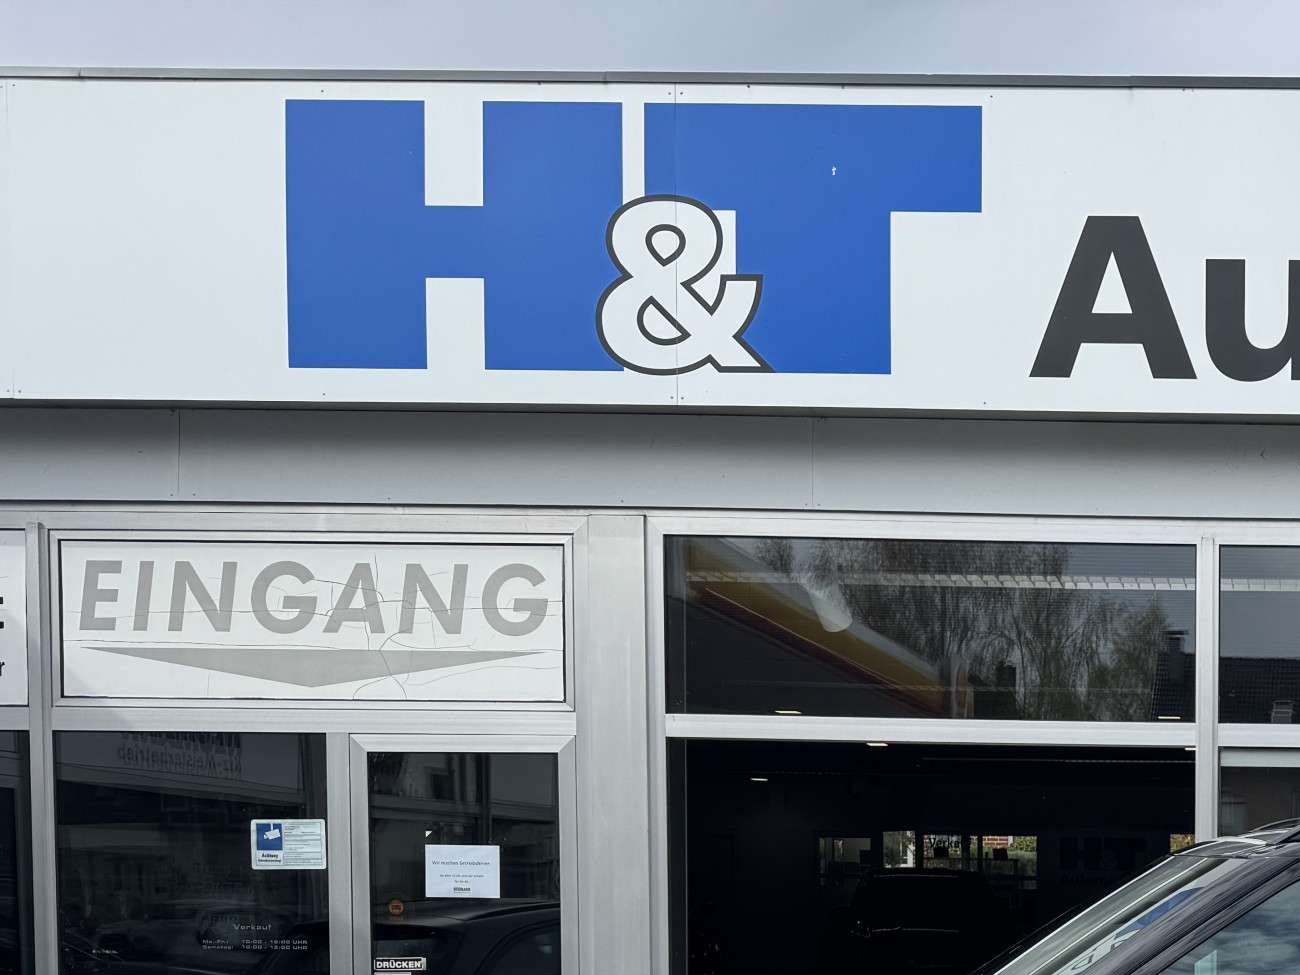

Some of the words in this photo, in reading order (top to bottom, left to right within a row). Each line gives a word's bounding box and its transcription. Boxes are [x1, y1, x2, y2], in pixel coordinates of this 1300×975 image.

[285, 98, 982, 375] H&T
[79, 560, 549, 637] EINGANG
[376, 959, 422, 969] DRÜCKEN
